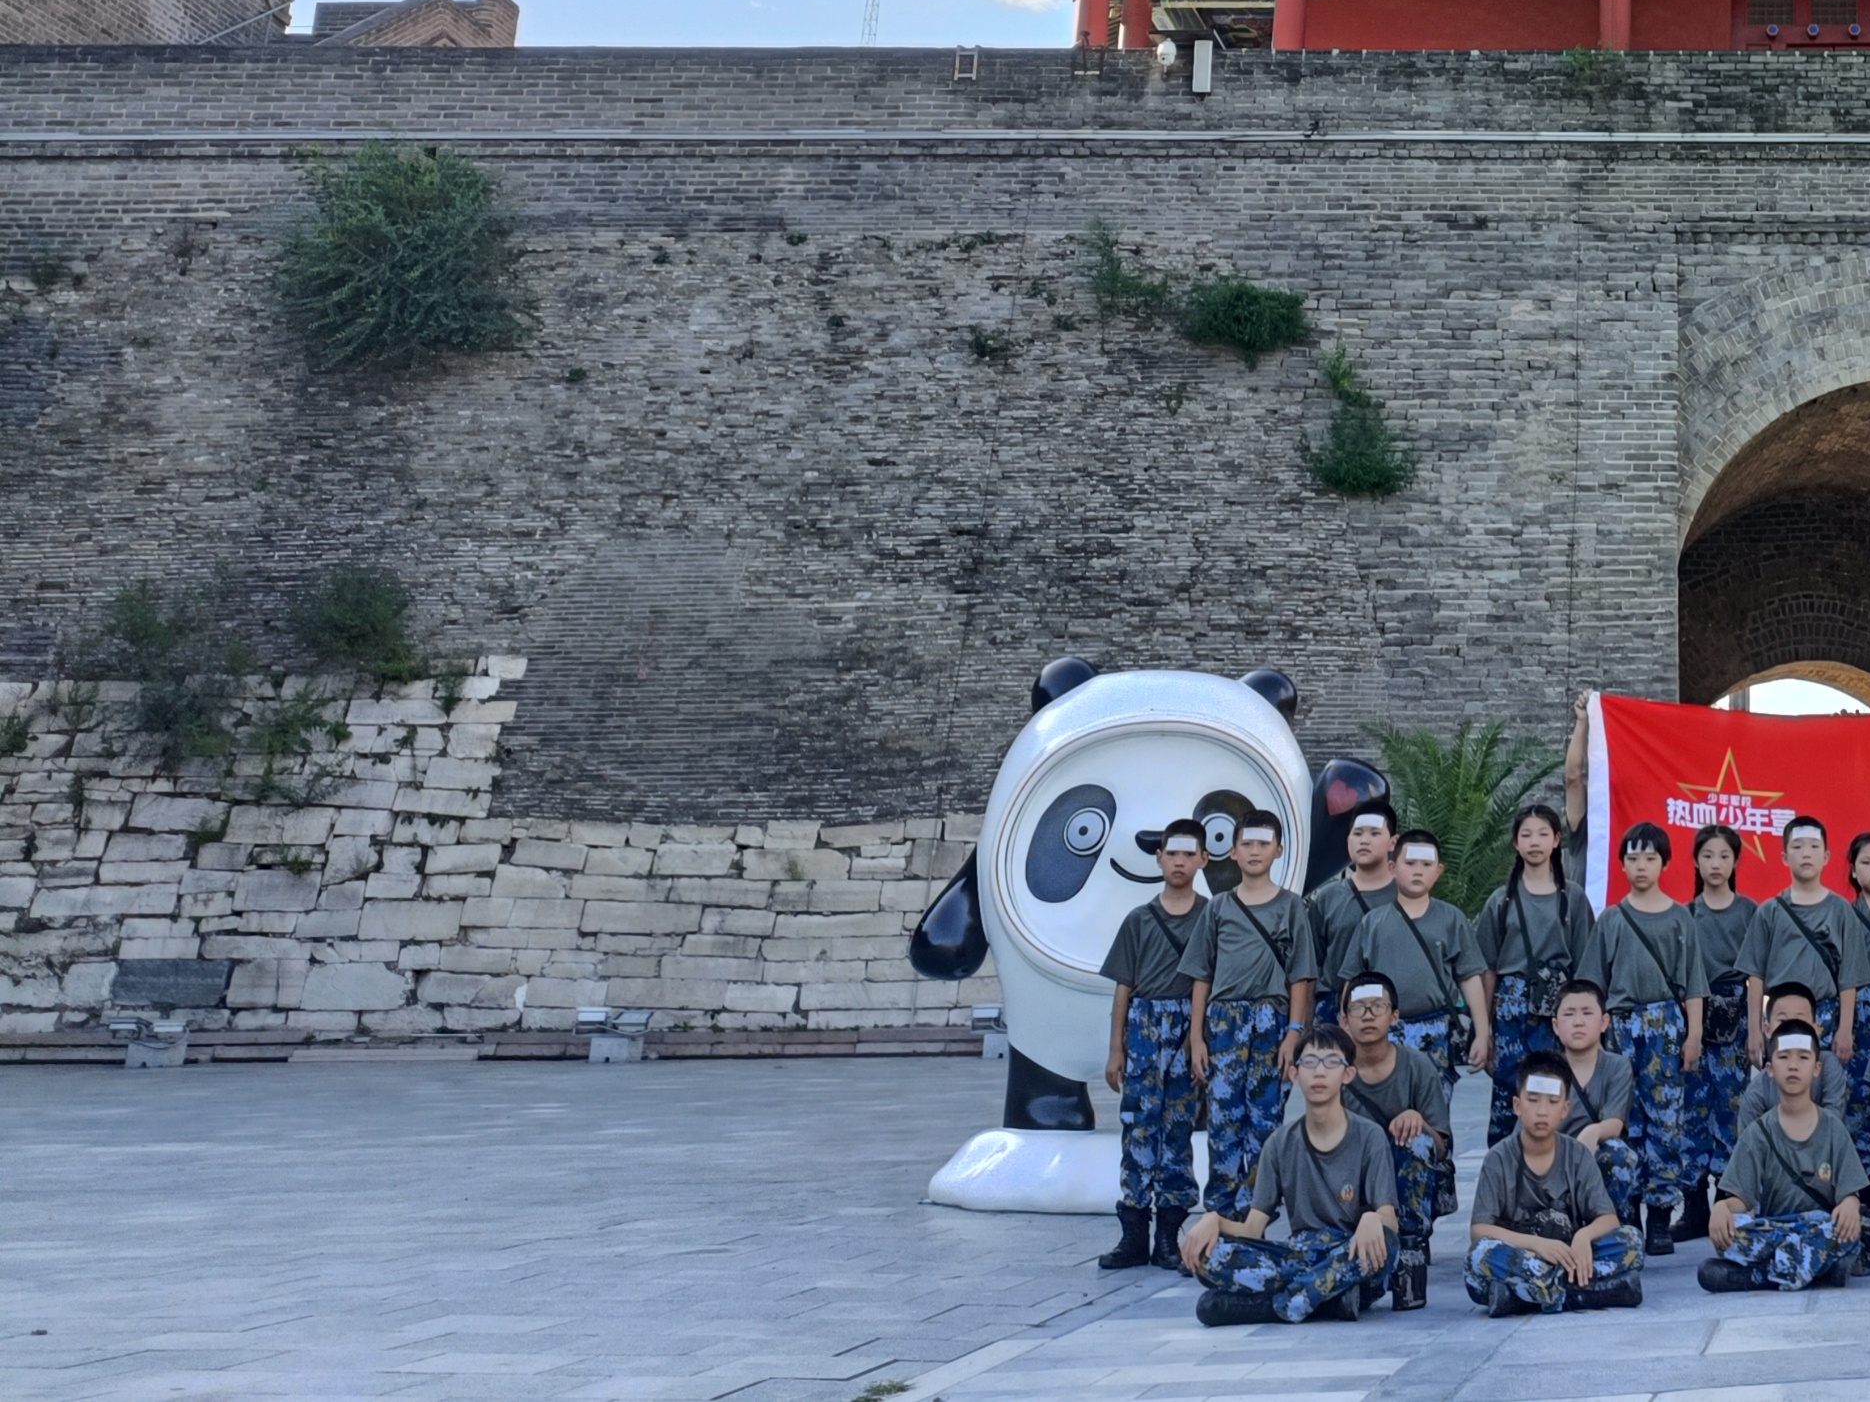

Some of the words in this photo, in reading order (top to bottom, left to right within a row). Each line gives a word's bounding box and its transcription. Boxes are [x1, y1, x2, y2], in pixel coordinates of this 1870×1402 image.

[1666, 797, 1796, 837] 热血少年营
